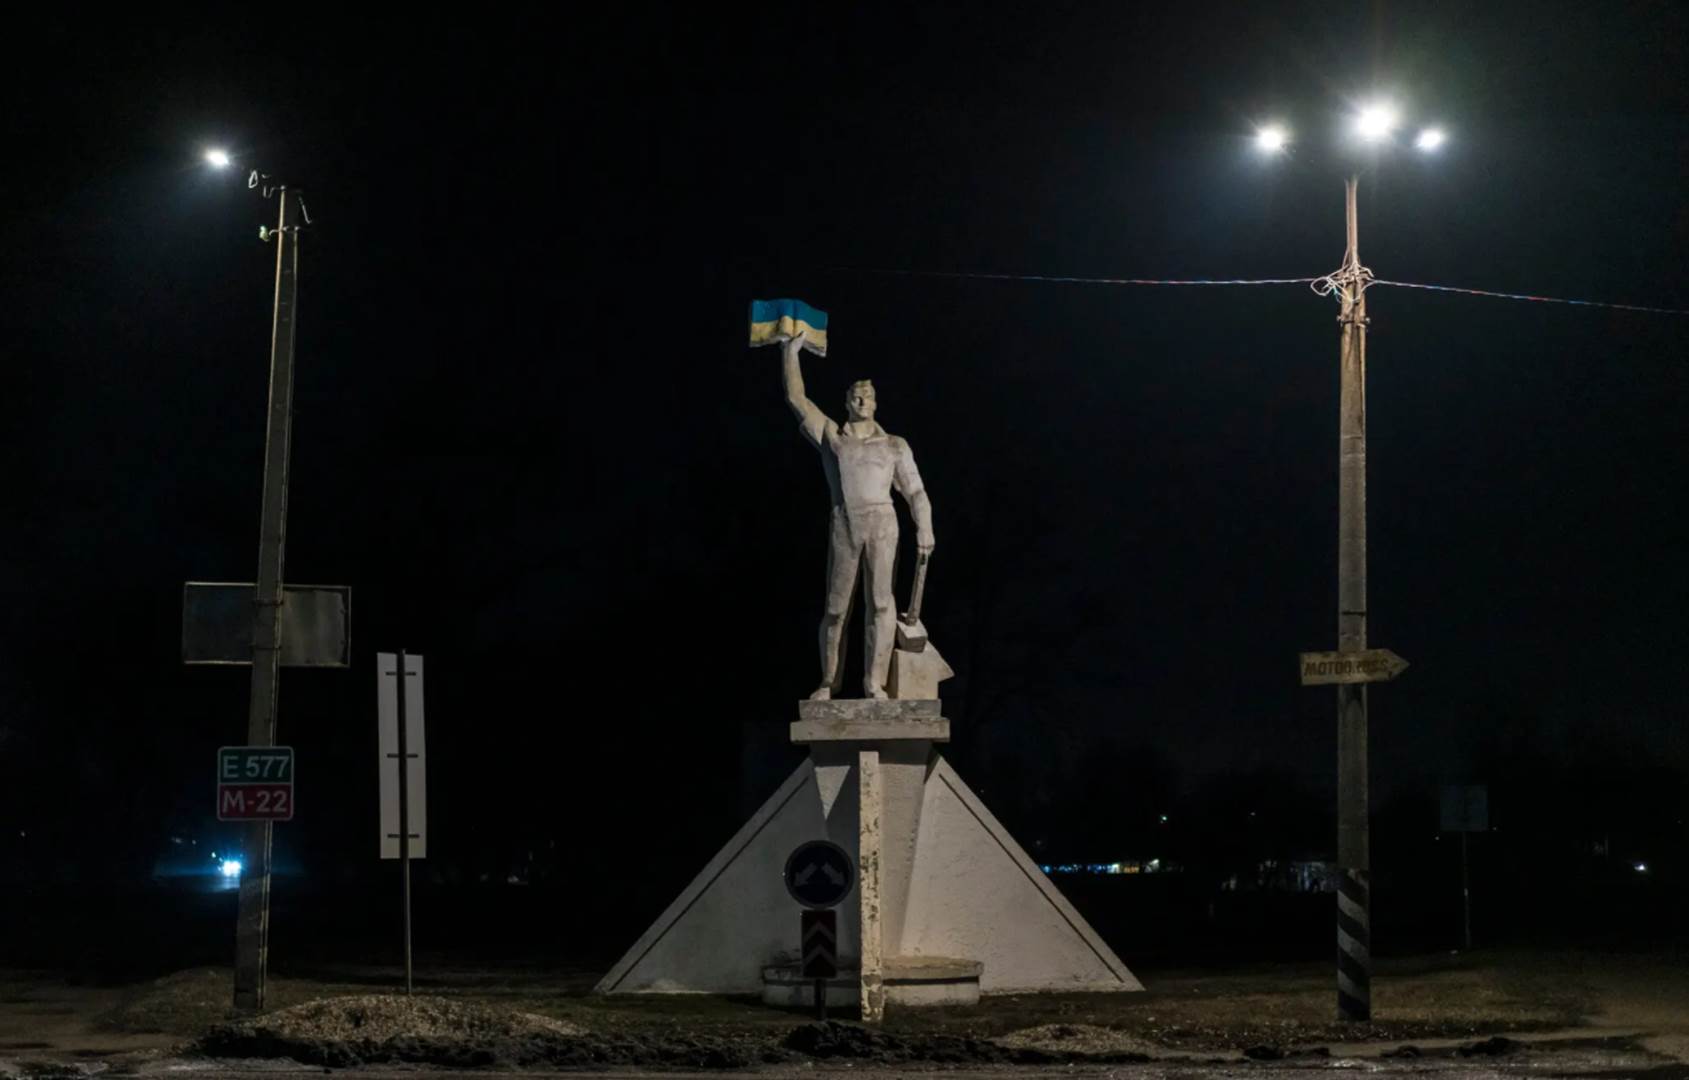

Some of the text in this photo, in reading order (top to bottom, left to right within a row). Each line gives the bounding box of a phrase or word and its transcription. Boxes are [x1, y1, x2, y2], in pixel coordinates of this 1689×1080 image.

[223, 755, 290, 778] E 577
[222, 790, 287, 814] M-22
